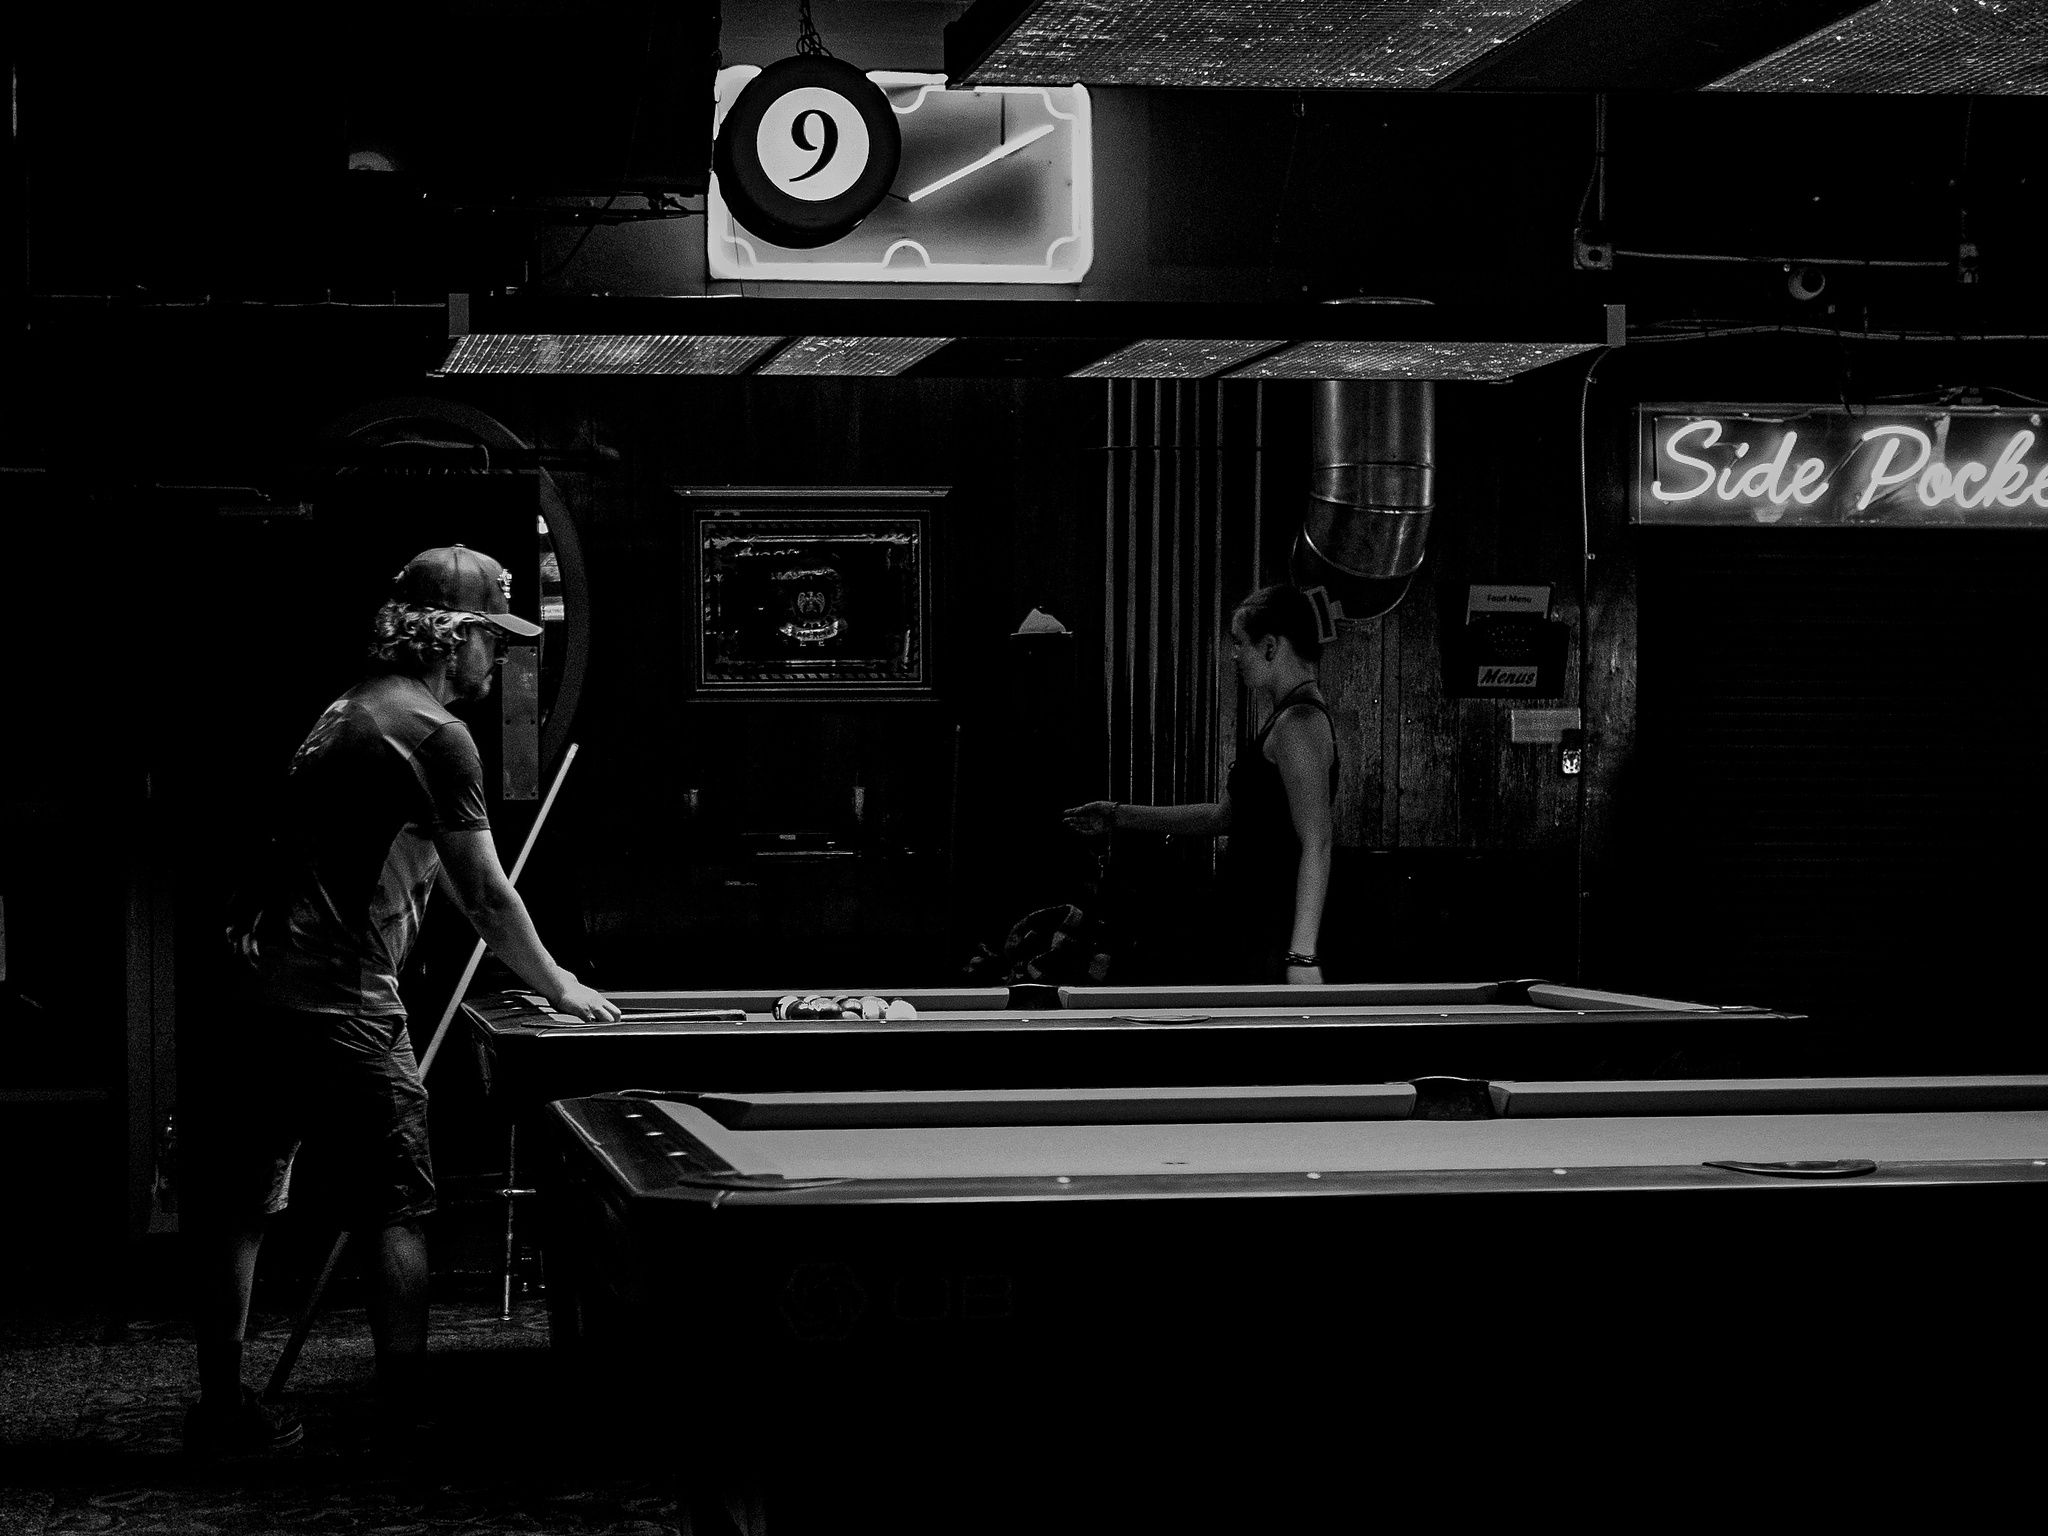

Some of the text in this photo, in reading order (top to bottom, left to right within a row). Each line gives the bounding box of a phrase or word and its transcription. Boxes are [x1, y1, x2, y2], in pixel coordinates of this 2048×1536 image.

[789, 109, 839, 183] 9
[1652, 419, 1830, 504] Side
[1487, 594, 1532, 603] Food Menu
[1481, 668, 1536, 685] Menus
